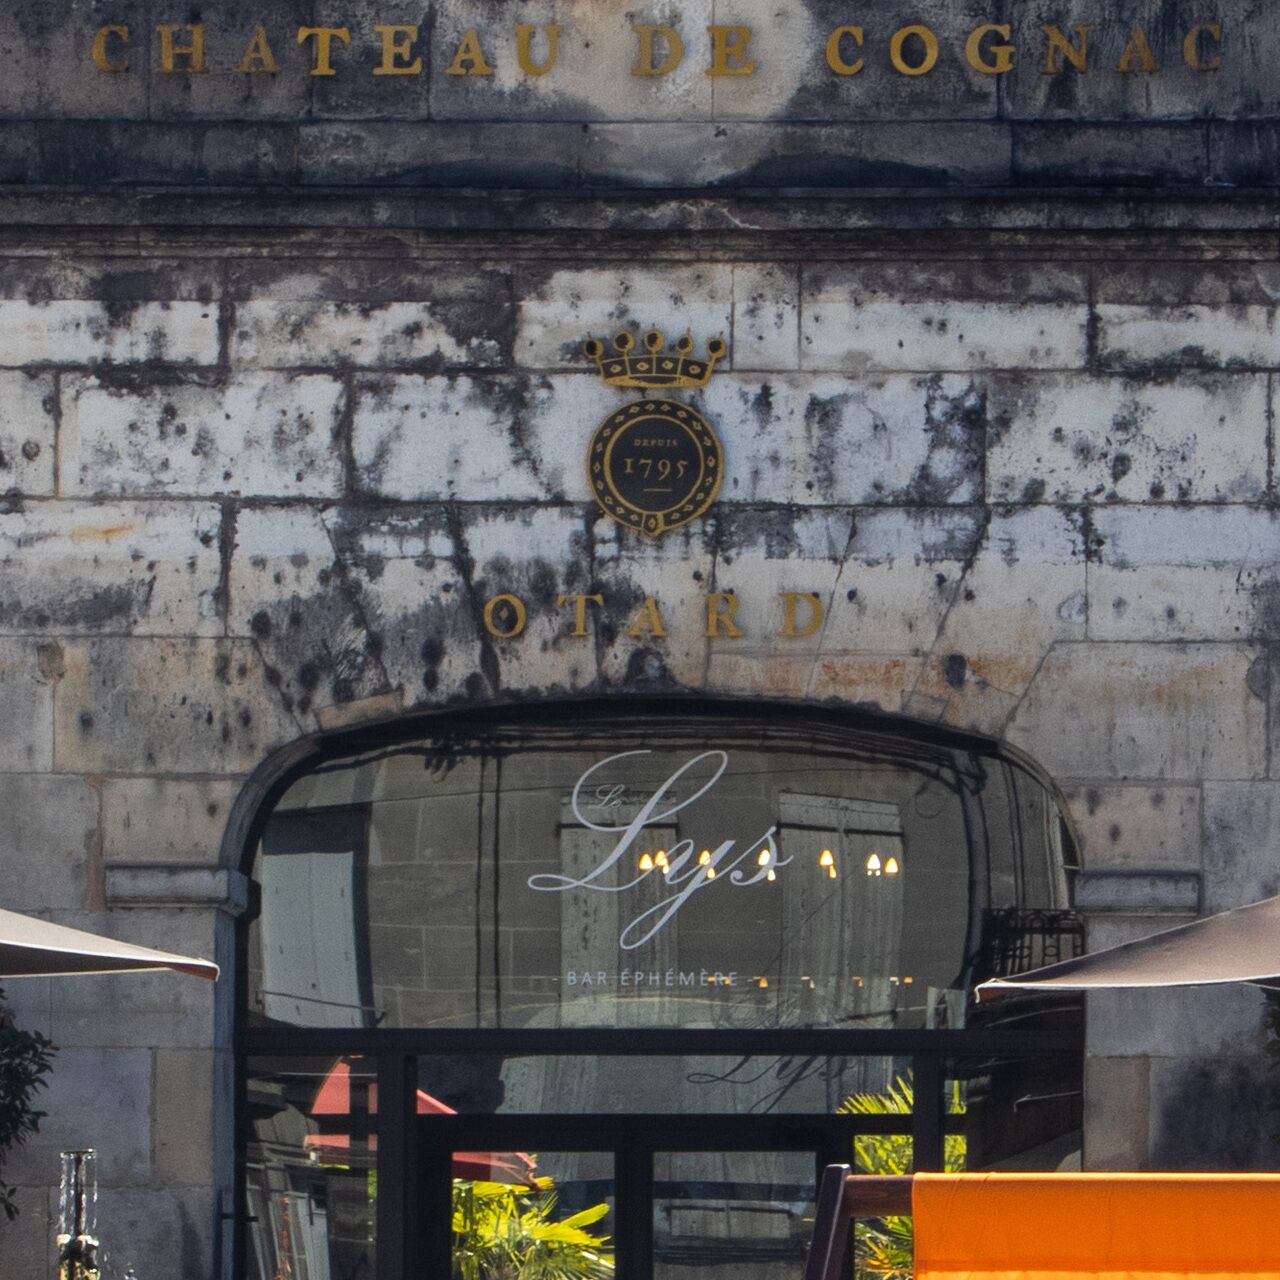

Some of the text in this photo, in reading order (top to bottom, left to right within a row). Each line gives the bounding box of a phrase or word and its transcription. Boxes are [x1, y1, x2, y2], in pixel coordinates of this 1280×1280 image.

[91, 23, 1225, 77] CHATEAU DE COGNAC
[623, 457, 689, 481] 1795
[483, 593, 825, 638] OTARD
[527, 749, 794, 950] Lys
[567, 967, 739, 986] BAR ÉPHÉMÈRE
